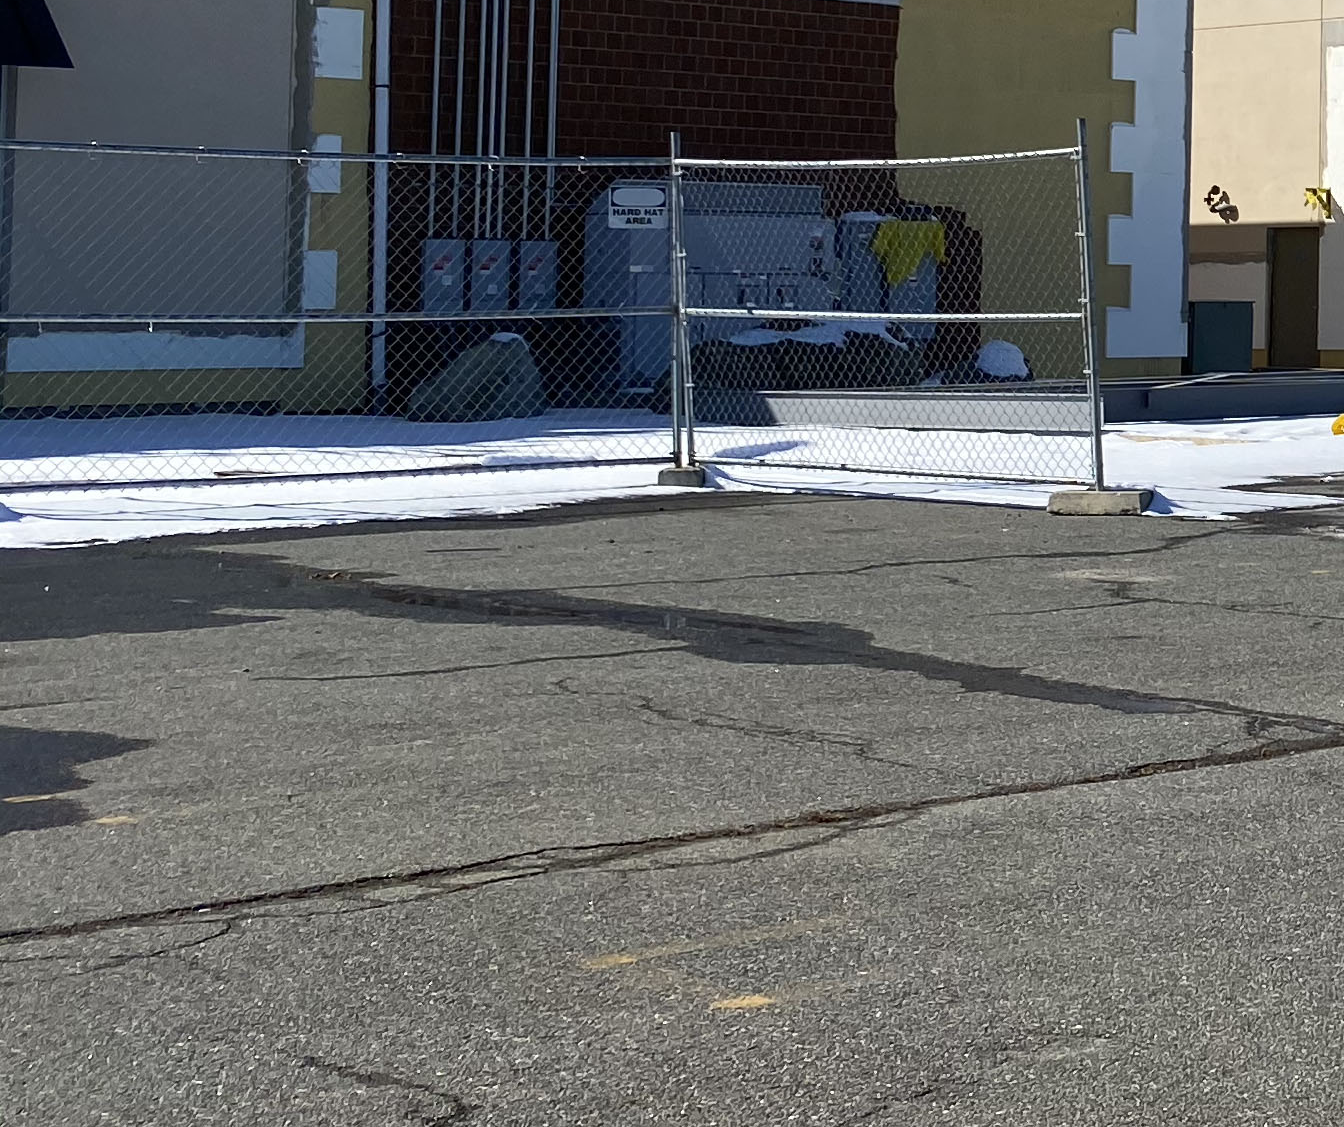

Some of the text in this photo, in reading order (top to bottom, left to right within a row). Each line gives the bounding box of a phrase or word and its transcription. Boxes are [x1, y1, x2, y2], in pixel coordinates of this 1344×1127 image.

[613, 208, 664, 216] HARD HAT
[625, 217, 653, 225] AREA
